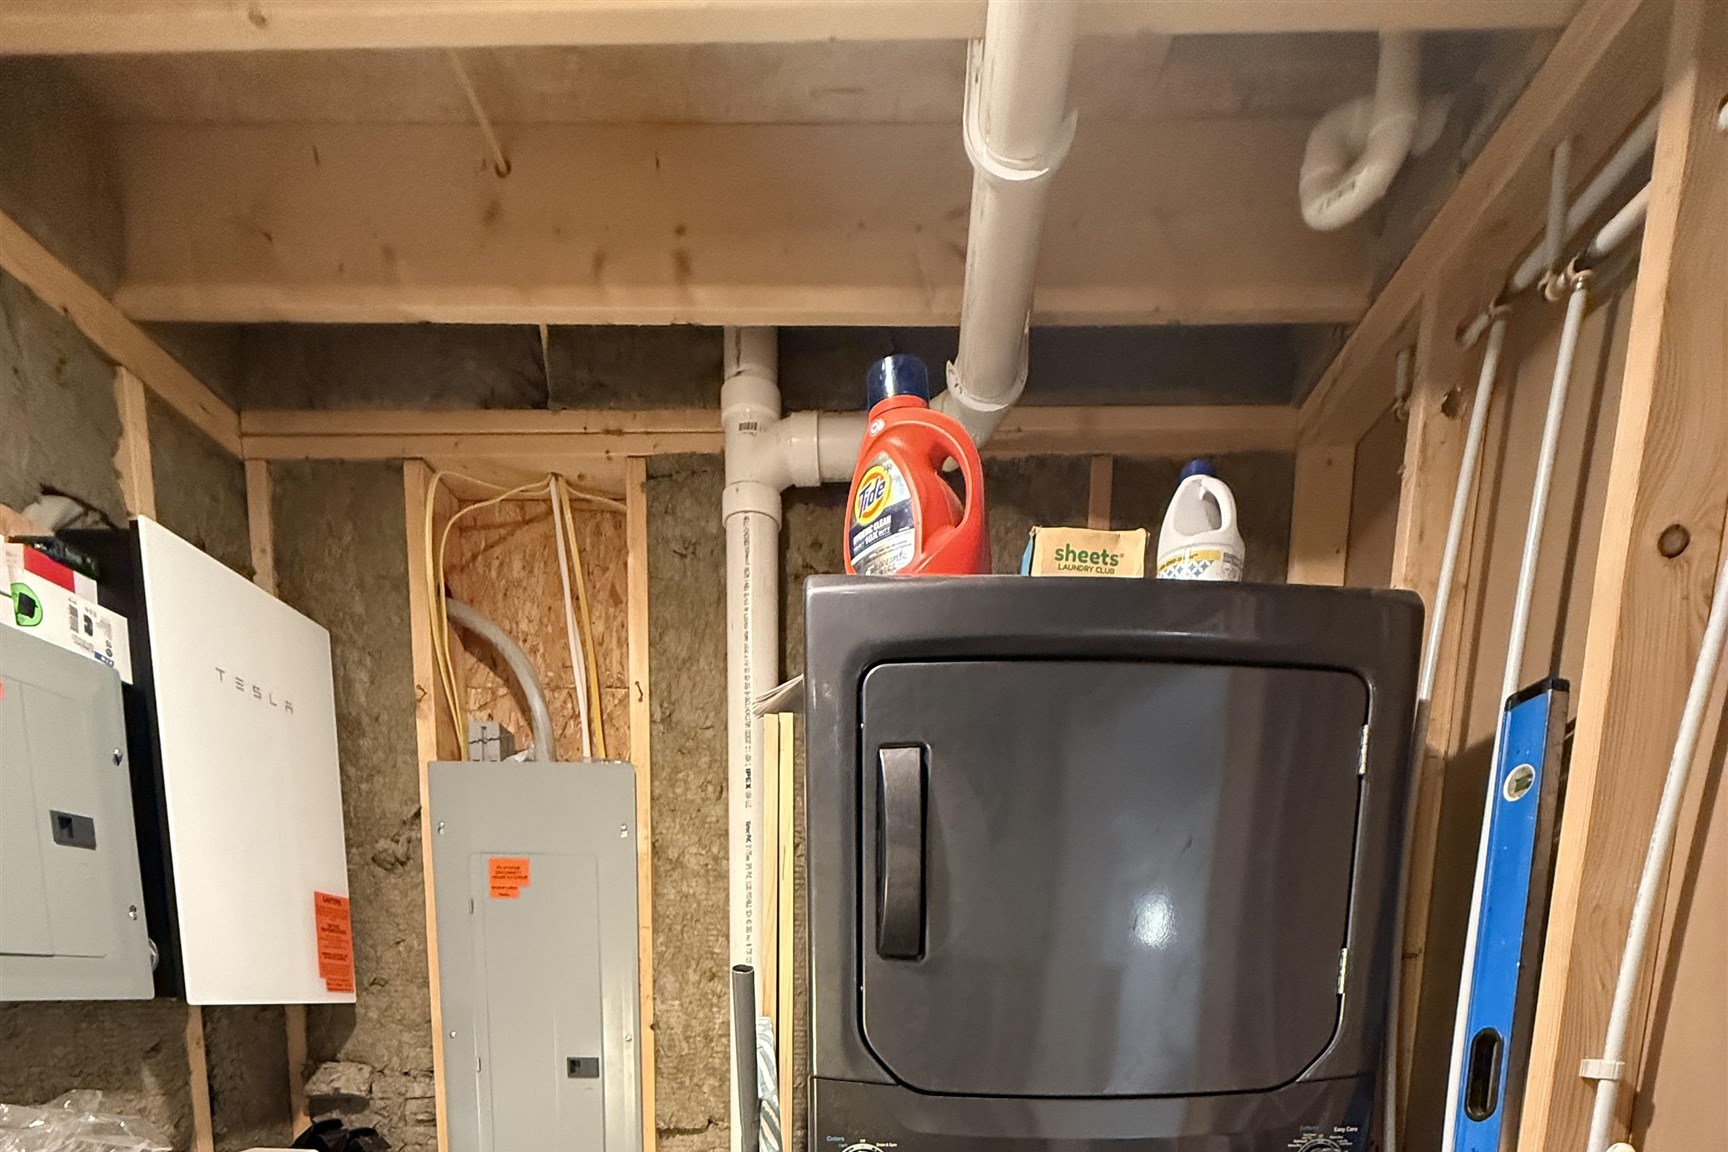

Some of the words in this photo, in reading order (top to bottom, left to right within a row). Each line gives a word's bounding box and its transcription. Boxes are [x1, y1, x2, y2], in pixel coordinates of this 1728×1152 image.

[859, 478, 886, 519] Tide
[1054, 543, 1119, 567] sheets
[1058, 562, 1094, 574] LAUNDRY
[1095, 566, 1115, 575] CLUB
[214, 666, 294, 715] TESLA
